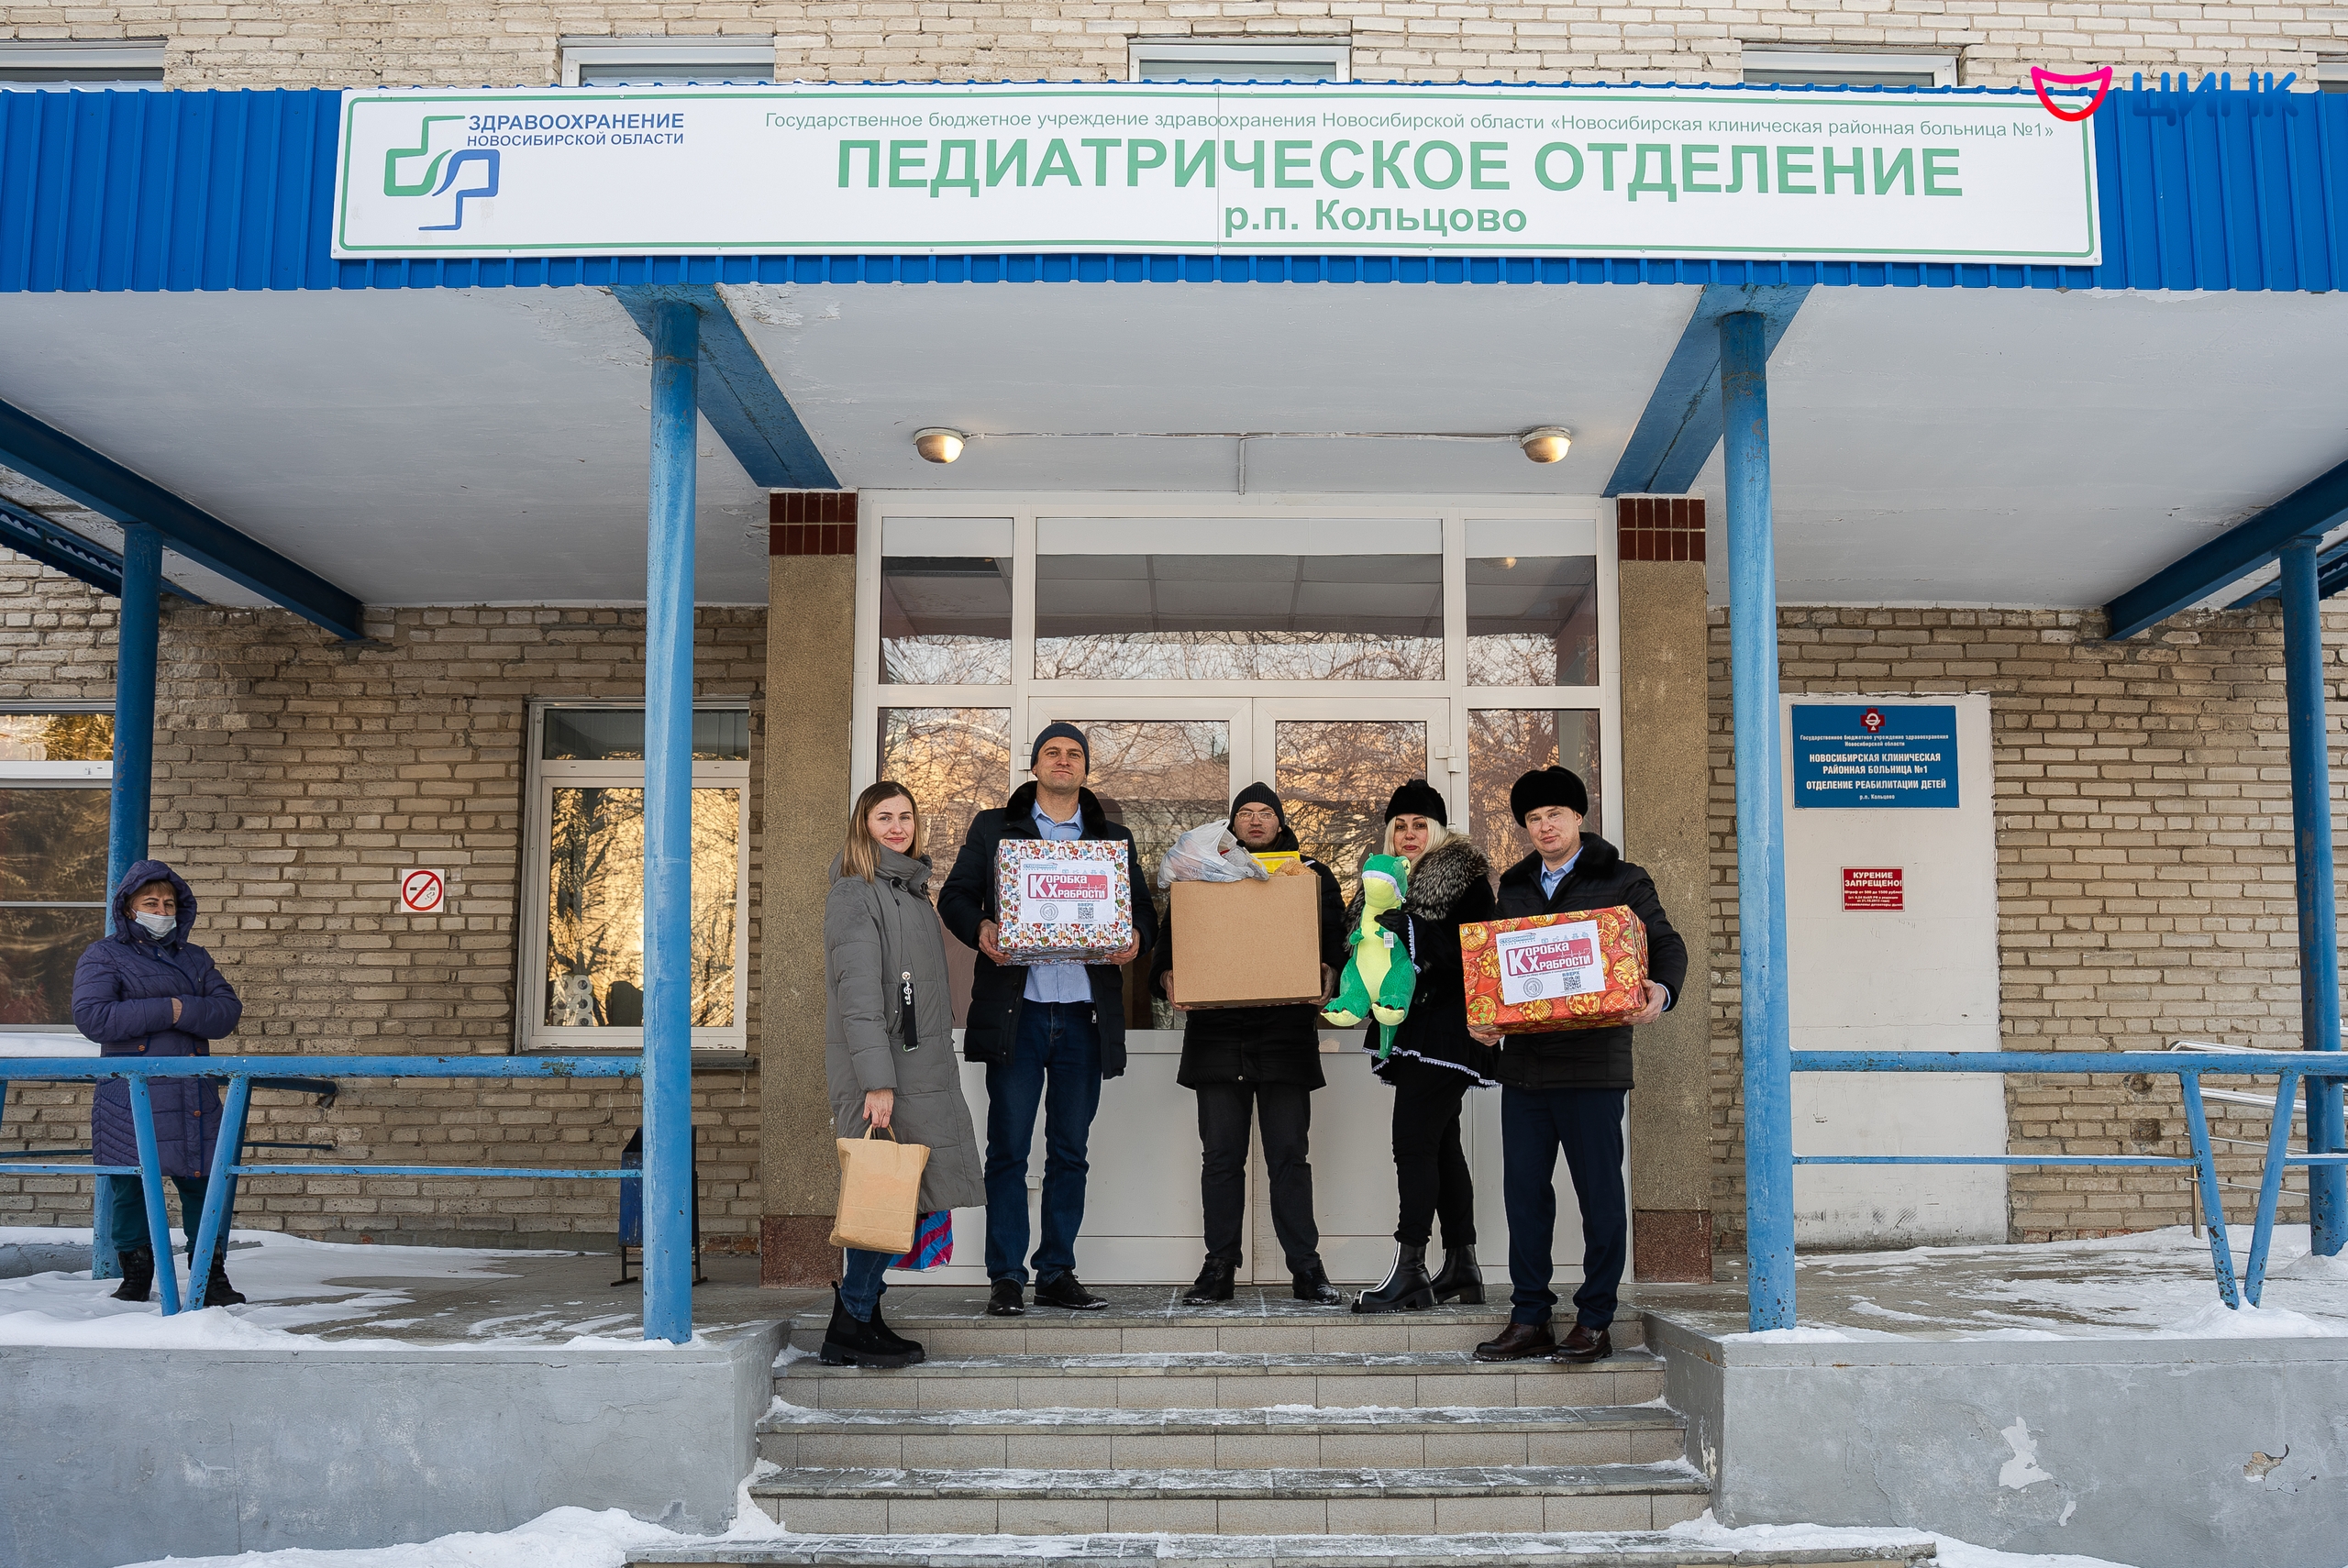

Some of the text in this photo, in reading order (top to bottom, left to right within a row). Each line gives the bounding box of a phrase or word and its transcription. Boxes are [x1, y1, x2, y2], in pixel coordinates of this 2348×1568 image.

[469, 113, 684, 133] ЗДРАВООХРАНЕНИЕ
[766, 112, 2054, 138] Государственное бюджетное учреждение здравоохранения Новосибирской области «Новосибирская клиническая районная больница №1»
[468, 131, 684, 147] НОВОСИБИРСКОЙ ОБЛАСТИ
[838, 138, 1963, 202] ПЕДИАТРИЧЕСКОЕ ОТДЕЛЕНИЕ
[1225, 199, 1527, 237] р.п. Кольцово
[1810, 753, 1941, 762] НОВОСИБИРСКАЯ КЛИНИЧЕСКАЯ
[1822, 765, 1928, 775] РАЙОННАЯ БОЛЬНИЦА №1
[1806, 778, 1946, 790] ОТДЕЛЕНИЕ РЕАБИЛИТАЦИИ ДЕТЕЙ
[1853, 871, 1893, 879] КУРЕНИЕ
[1844, 879, 1902, 888] ЗАПРЕЩЕНО!
